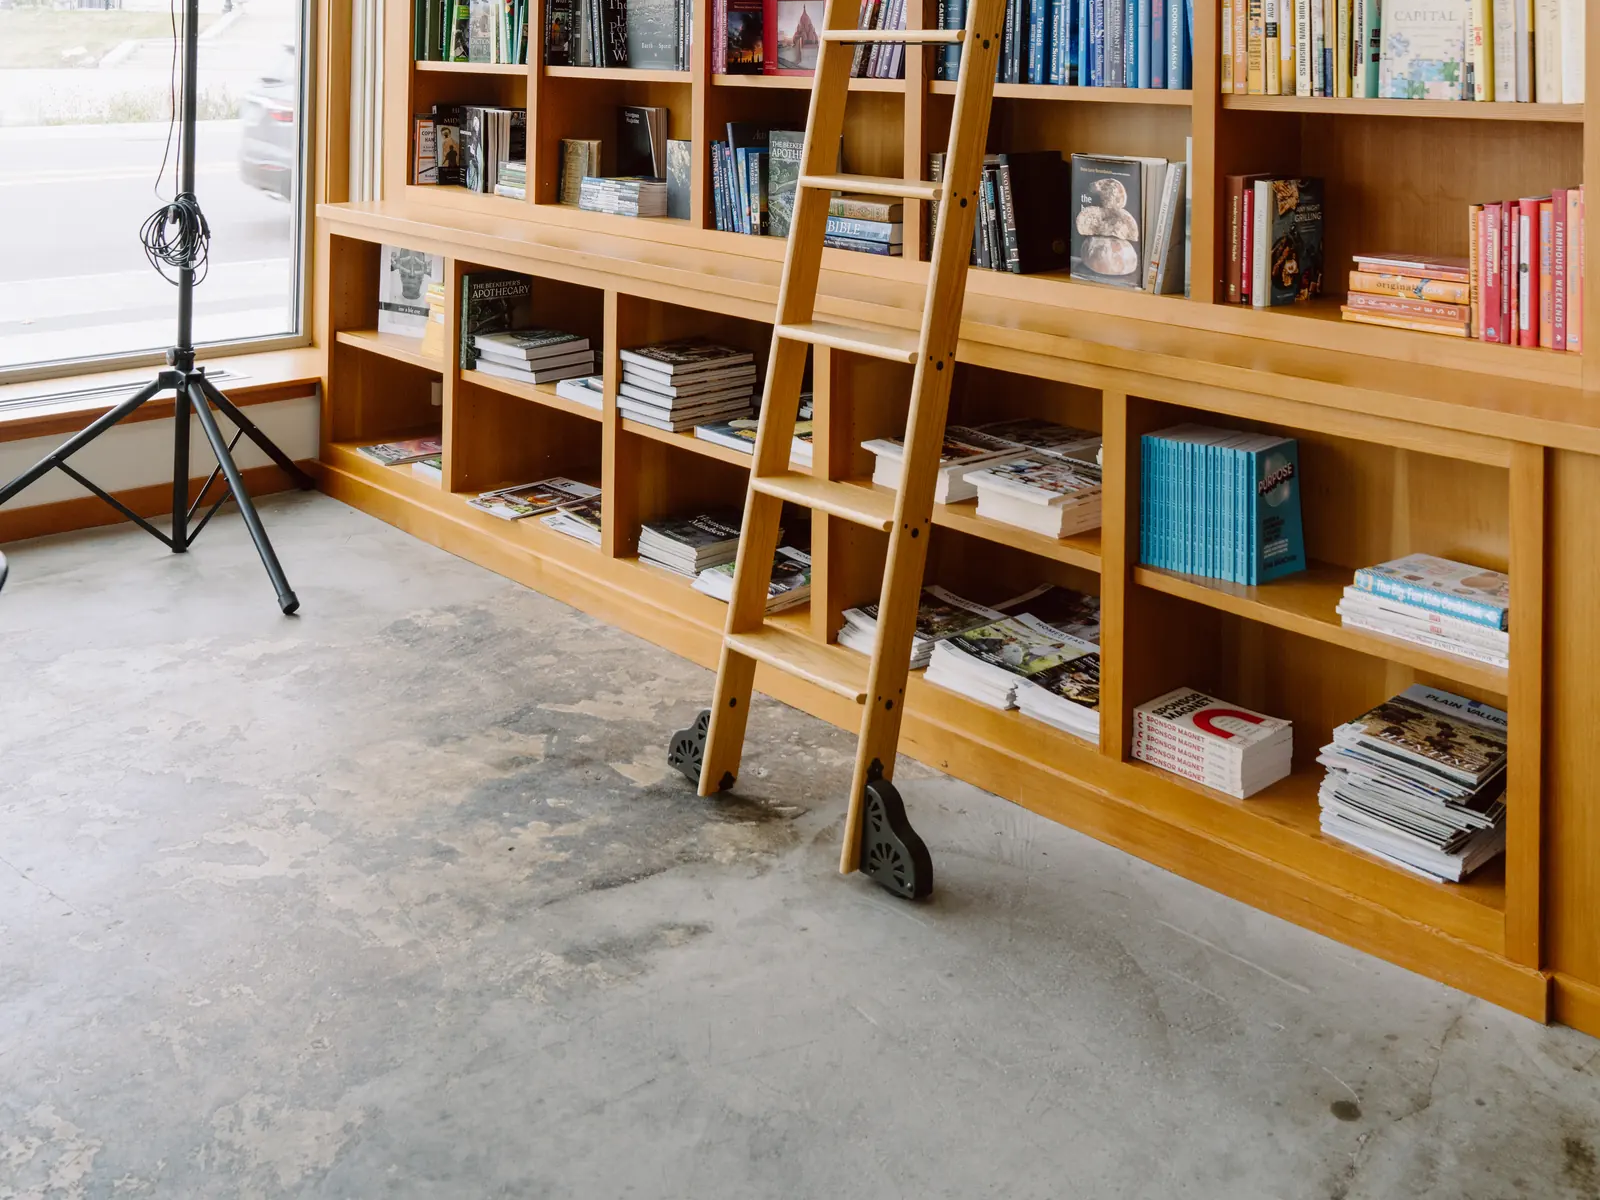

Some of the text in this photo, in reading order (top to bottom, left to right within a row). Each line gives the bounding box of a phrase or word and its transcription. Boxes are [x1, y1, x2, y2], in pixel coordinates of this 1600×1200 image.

[1266, 2, 1274, 18] COW
[1298, 1, 1306, 20] YOUR
[1394, 11, 1458, 22] CAPITAL
[1235, 15, 1246, 63] Vegetables
[1298, 22, 1306, 40] OWN
[1298, 42, 1306, 76] BUSINESS
[772, 141, 782, 149] THE
[1003, 171, 1014, 224] WORLD BOOK
[1080, 194, 1092, 204] the
[1294, 213, 1322, 223] GRILLING
[1296, 205, 1304, 213] ANY
[1305, 204, 1320, 214] NIGHT
[828, 221, 861, 235] BIBLE
[472, 285, 530, 299] APOTHECARY
[485, 280, 521, 289] BEEKEEPER'S
[1356, 297, 1458, 318] DRIFTLESS
[1258, 463, 1294, 494] PURPOSE
[1376, 579, 1391, 591] The
[1035, 621, 1085, 646] HOMESTEAD
[1152, 693, 1202, 716] SPONSOR
[1162, 697, 1215, 722] MAGNET
[1425, 693, 1507, 726] PLAIN VALUES
[1146, 715, 1205, 743] SPONSOR MAGNET
[1147, 725, 1205, 752] SPONSOR MAGNET
[1145, 744, 1204, 772] SPONSOR MAGNET
[1147, 735, 1204, 762] SPONSOR MAGNET
[1145, 754, 1206, 783] SPONSOR MAGNET
